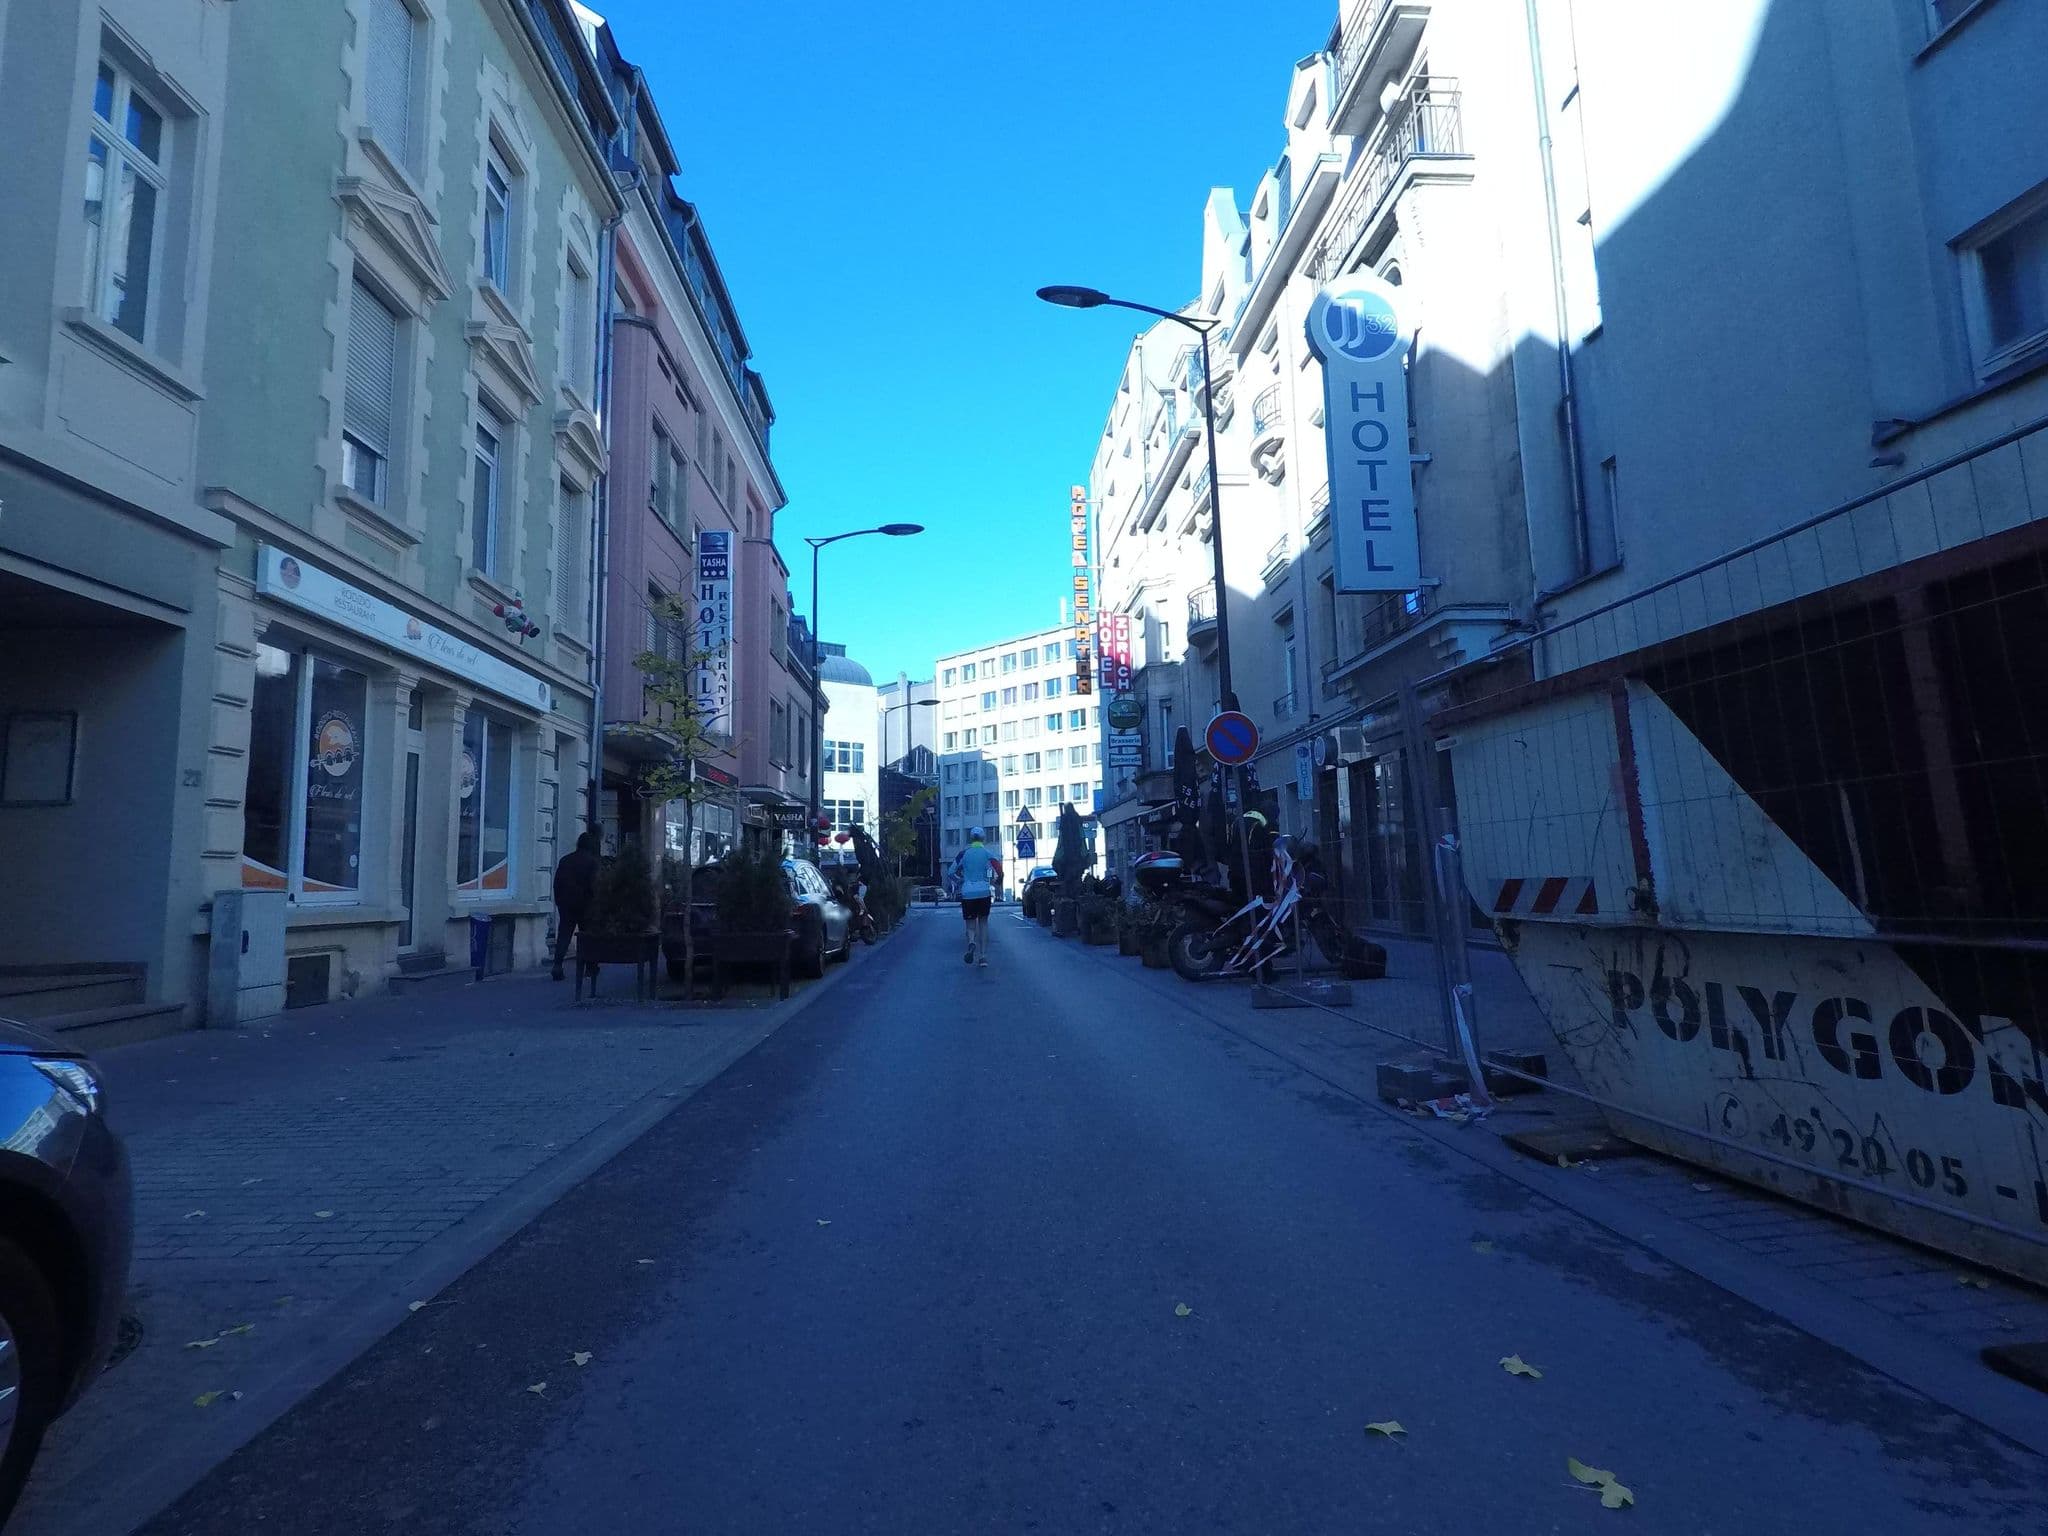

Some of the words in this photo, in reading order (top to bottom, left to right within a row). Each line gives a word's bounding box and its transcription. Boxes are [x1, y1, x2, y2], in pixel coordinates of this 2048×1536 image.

[1366, 313, 1397, 336] 32
[1350, 381, 1394, 572] HOTEL
[701, 557, 727, 568] YASHA
[1071, 485, 1088, 568] HOTEL
[718, 591, 728, 706] RESTAURANT
[1073, 575, 1091, 695] SENATOR
[1099, 612, 1113, 687] HOTEL
[1115, 617, 1130, 690] ZURICH
[774, 813, 804, 821] YASHA
[1832, 1128, 1888, 1176] 20
[1906, 1149, 1968, 1198] 05
